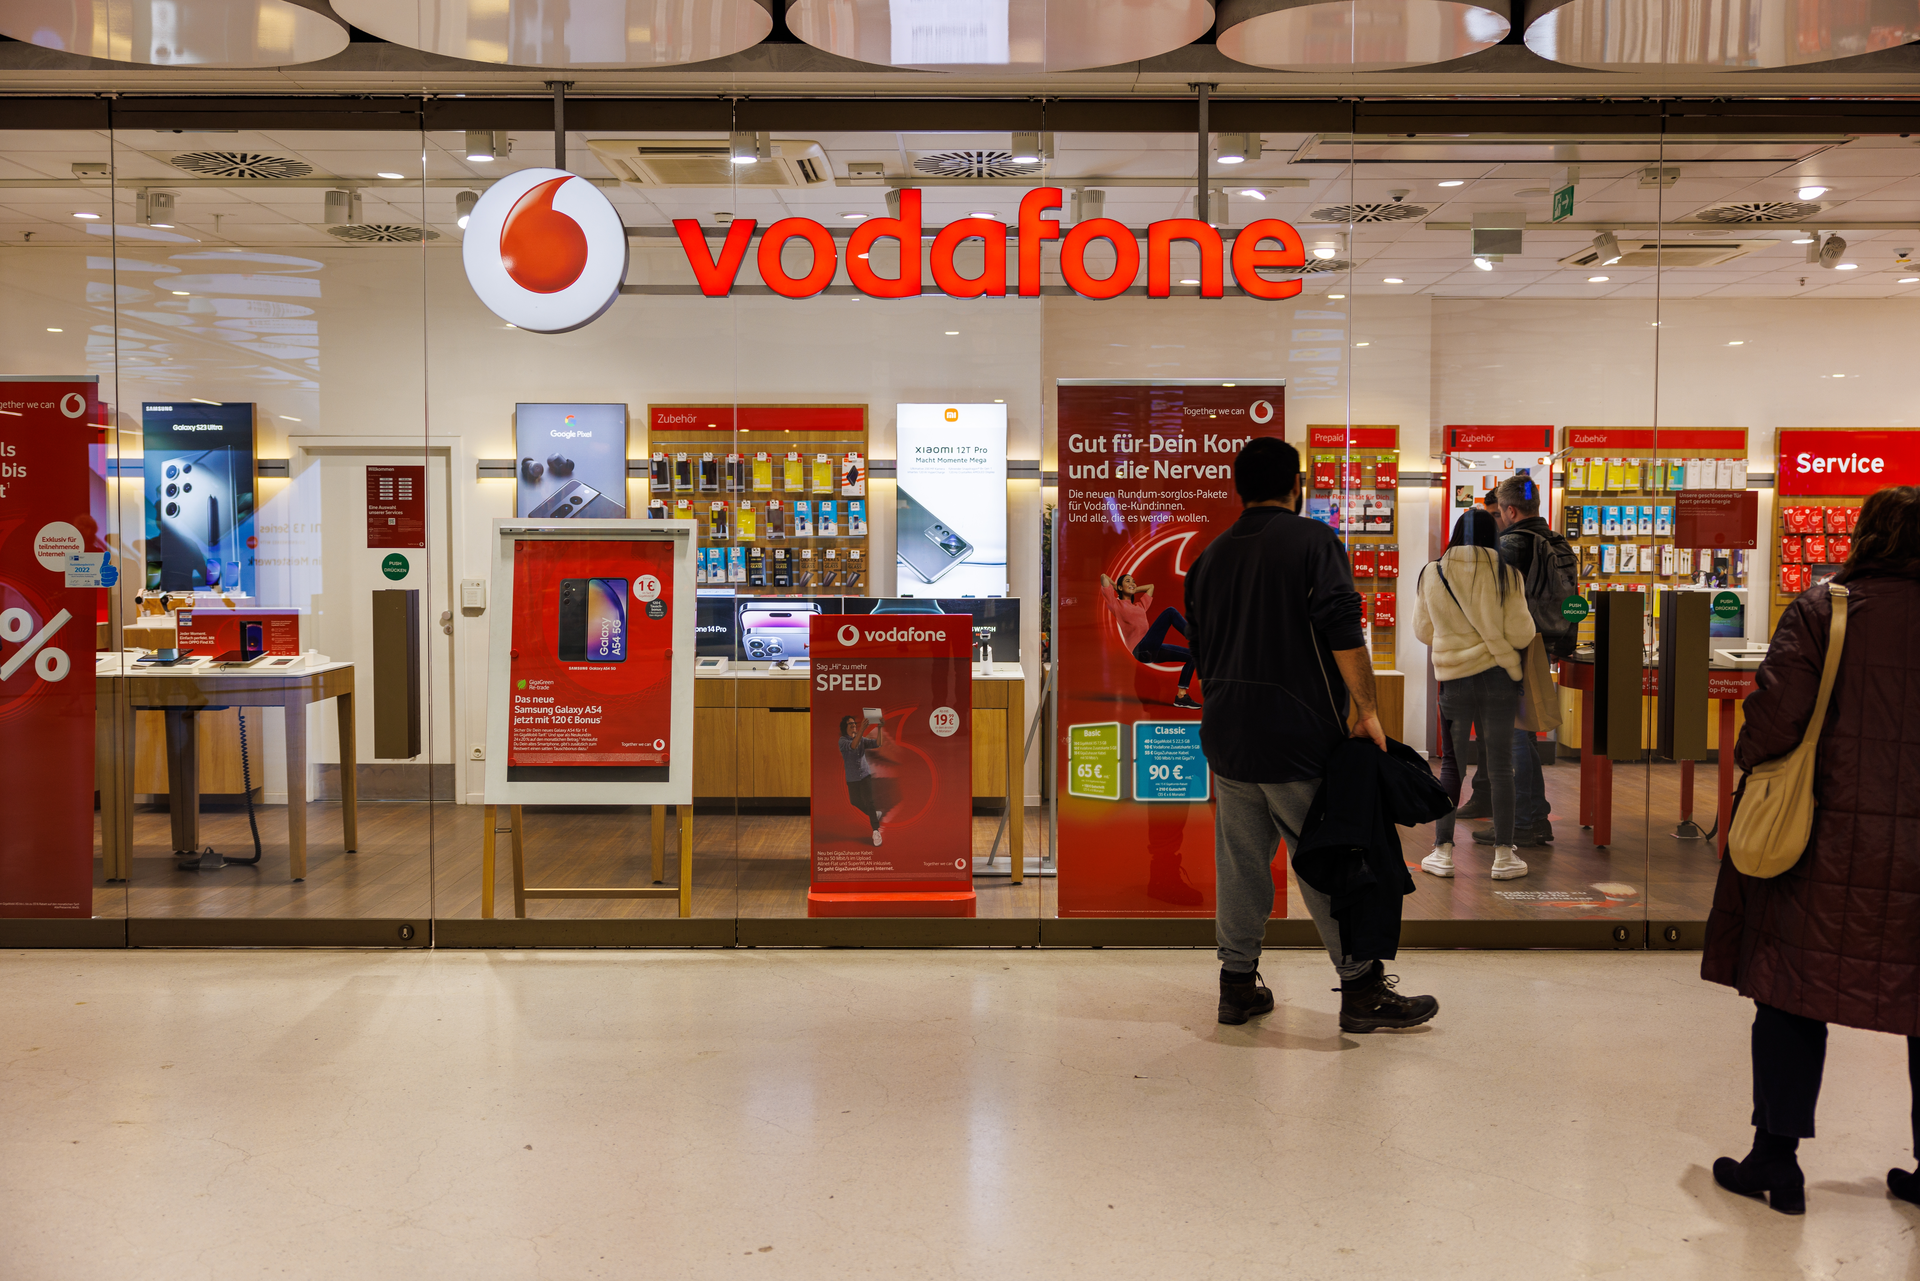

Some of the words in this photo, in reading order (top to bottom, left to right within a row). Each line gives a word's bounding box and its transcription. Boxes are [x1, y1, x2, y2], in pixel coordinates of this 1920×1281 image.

[672, 187, 1306, 300] vodafone
[1183, 407, 1216, 416] Together
[657, 414, 697, 424] Zubehör
[172, 424, 196, 432] Galaxy
[550, 430, 576, 440] Google
[1315, 433, 1344, 443] Prepaid
[1461, 434, 1495, 443] Zubehör
[1574, 434, 1607, 443] Zubehör
[1068, 434, 1107, 453] Gut
[1112, 433, 1144, 453] für
[1149, 434, 1197, 453] Dein
[1203, 434, 1254, 453] Kon
[1796, 452, 1885, 473] Service
[1, 462, 27, 478] bis
[1068, 460, 1109, 479] und
[1115, 460, 1148, 479] die
[1154, 460, 1231, 479] Nerven
[1068, 490, 1084, 499] Die
[1086, 491, 1115, 499] neuen
[1117, 490, 1228, 501] Rundum-sorglos-Pakete
[1068, 501, 1081, 511] für
[1083, 501, 1186, 511] Vodafone-Kund:innen.
[1068, 513, 1088, 523] Und
[1090, 513, 1109, 524] alle,
[1111, 513, 1125, 523] die
[1127, 515, 1138, 523] es
[1140, 513, 1175, 523] werden
[1176, 513, 1210, 523] wollen.
[638, 580, 644, 591] 1
[647, 580, 655, 591] €
[612, 619, 622, 635] 5G
[600, 617, 612, 656] Galaxy
[864, 626, 946, 642] vodafone
[0, 607, 73, 682] %
[612, 635, 622, 656] A54
[816, 663, 828, 671] Sag
[816, 674, 882, 691] SPEED
[515, 695, 531, 703] Das
[514, 706, 553, 715] Samsung
[555, 706, 582, 715] Galaxy
[514, 716, 533, 725] jetzt
[535, 716, 549, 724] mit
[551, 716, 566, 724] 120
[567, 716, 573, 724] €
[933, 714, 948, 725] 19
[1155, 726, 1186, 735] Classic
[1077, 764, 1092, 778] 65
[1093, 764, 1103, 779] €
[1149, 764, 1170, 780] 90
[1172, 764, 1184, 780] €
